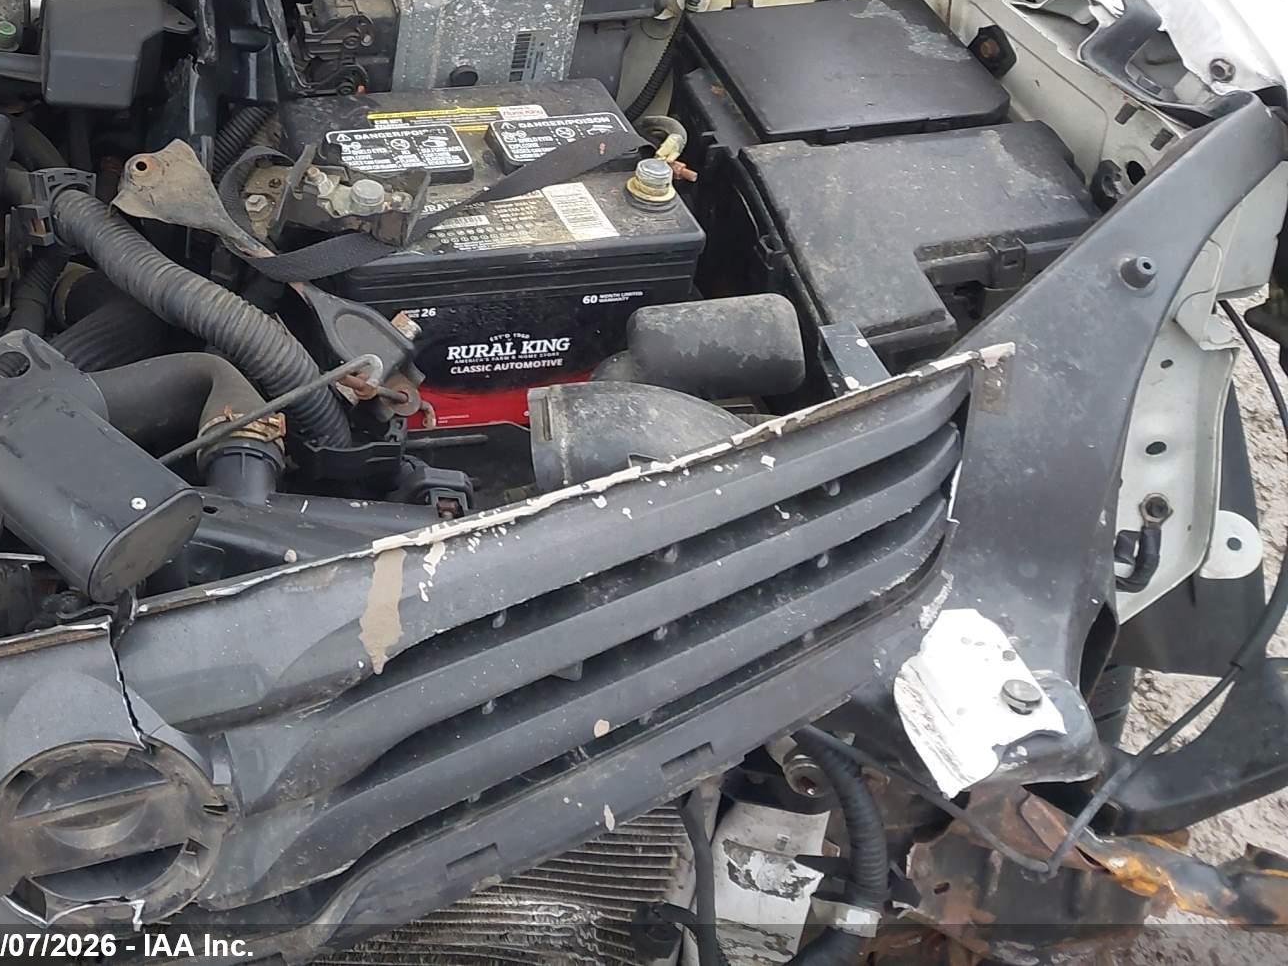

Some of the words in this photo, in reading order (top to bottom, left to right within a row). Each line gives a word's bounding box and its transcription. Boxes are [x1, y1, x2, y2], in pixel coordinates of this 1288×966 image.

[582, 295, 598, 305] 60
[421, 307, 436, 317] 26
[447, 342, 517, 361] RURAL
[520, 337, 571, 354] KING
[450, 364, 492, 374] CLASSIC
[493, 359, 564, 371] AUTOMOTIVE
